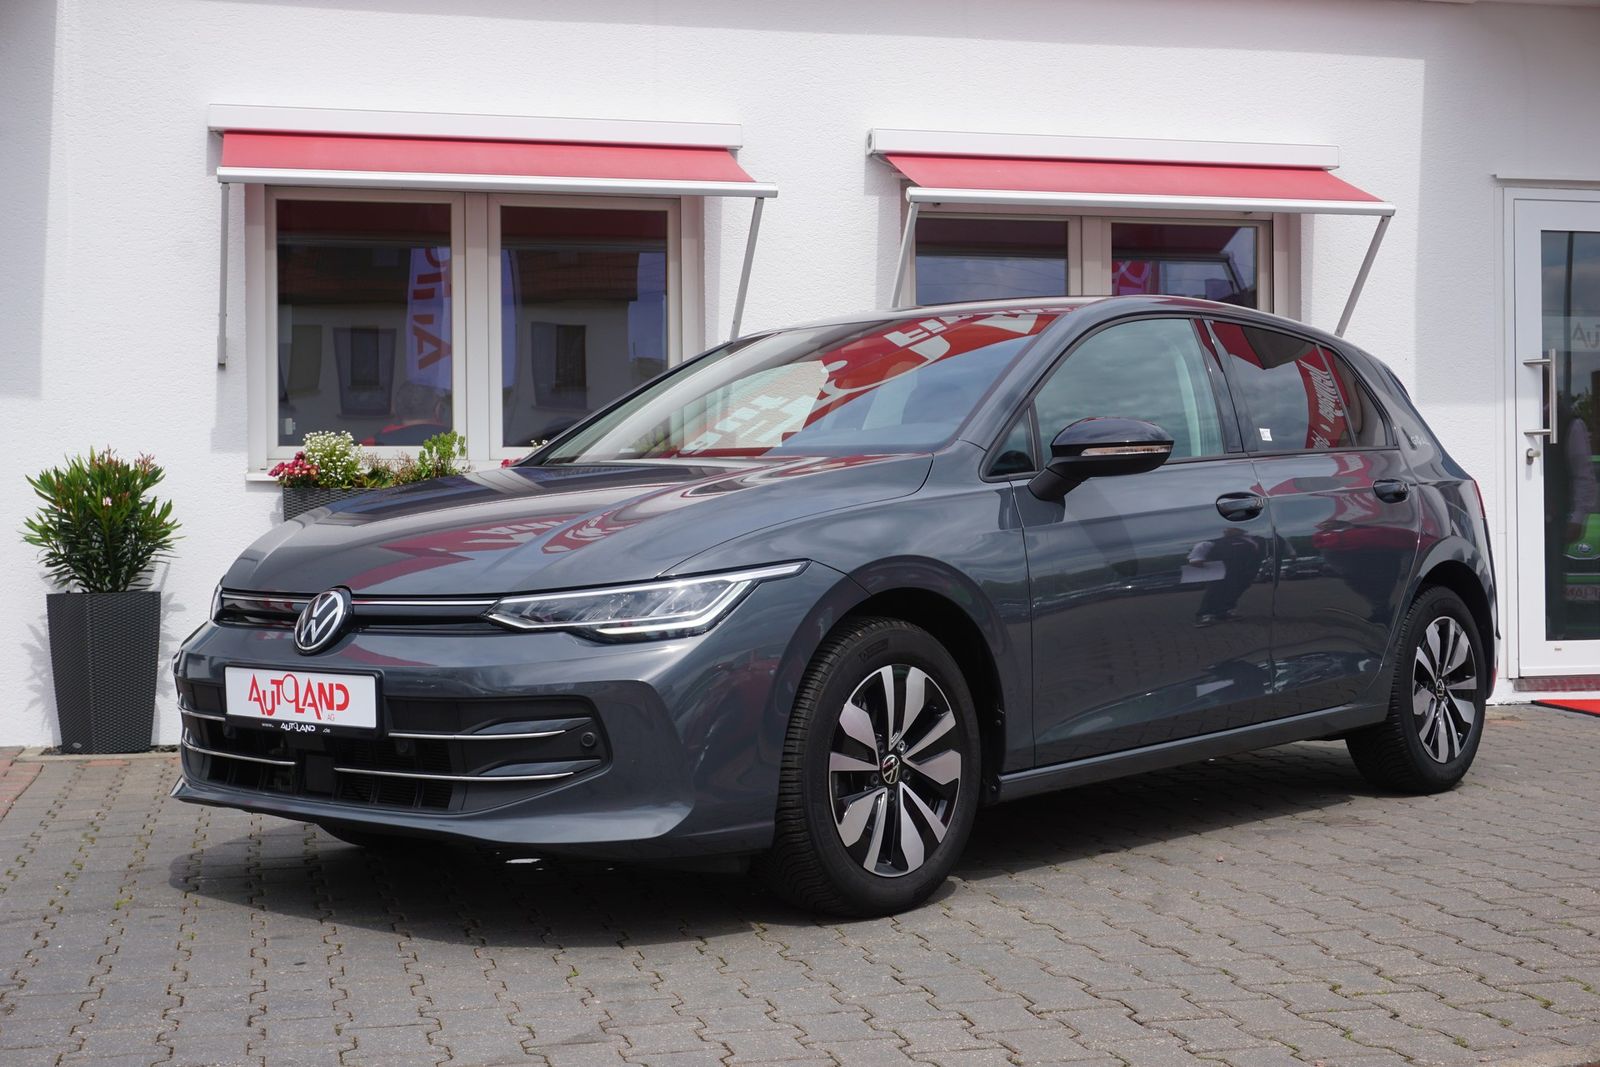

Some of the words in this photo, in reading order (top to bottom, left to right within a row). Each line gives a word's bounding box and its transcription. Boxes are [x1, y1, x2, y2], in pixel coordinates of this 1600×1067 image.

[248, 673, 350, 720] AUTOLAND
[327, 713, 335, 722] AG
[280, 721, 316, 733] AUTOLAND
